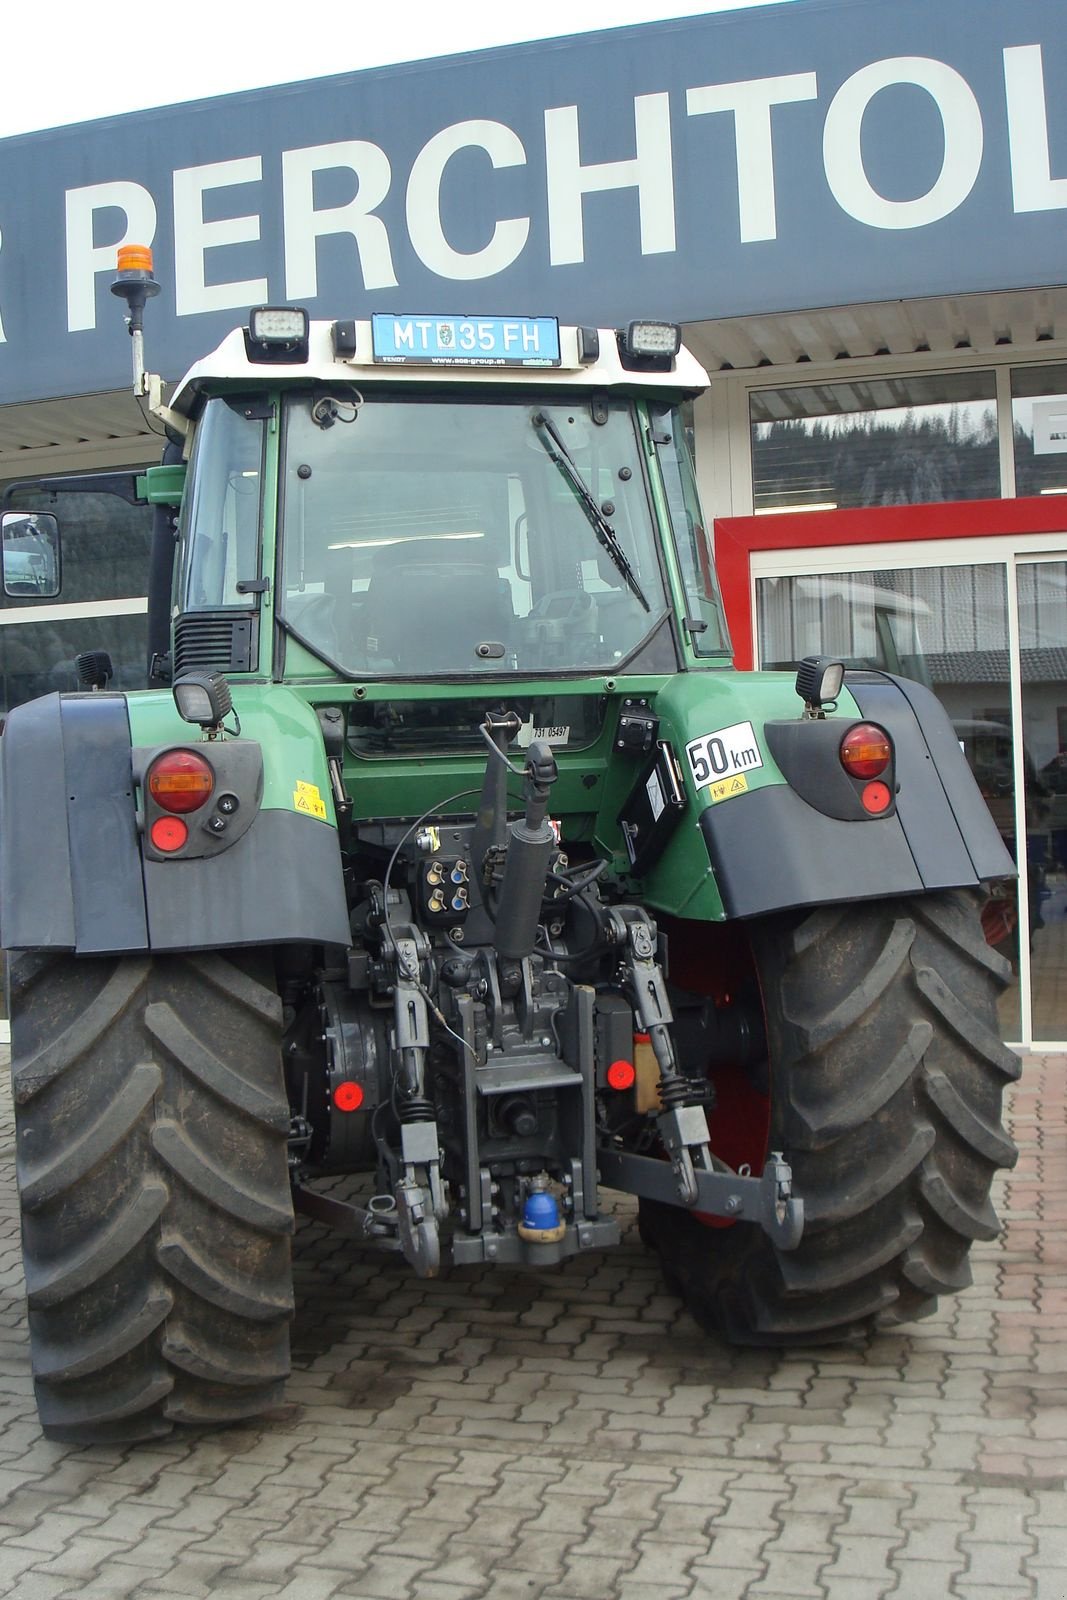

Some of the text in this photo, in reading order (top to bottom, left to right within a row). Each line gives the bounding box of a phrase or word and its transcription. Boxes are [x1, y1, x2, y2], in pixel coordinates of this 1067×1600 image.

[393, 321, 540, 351] MT 35 FH
[534, 726, 567, 738] 731 05497
[688, 737, 757, 782] 50 km
